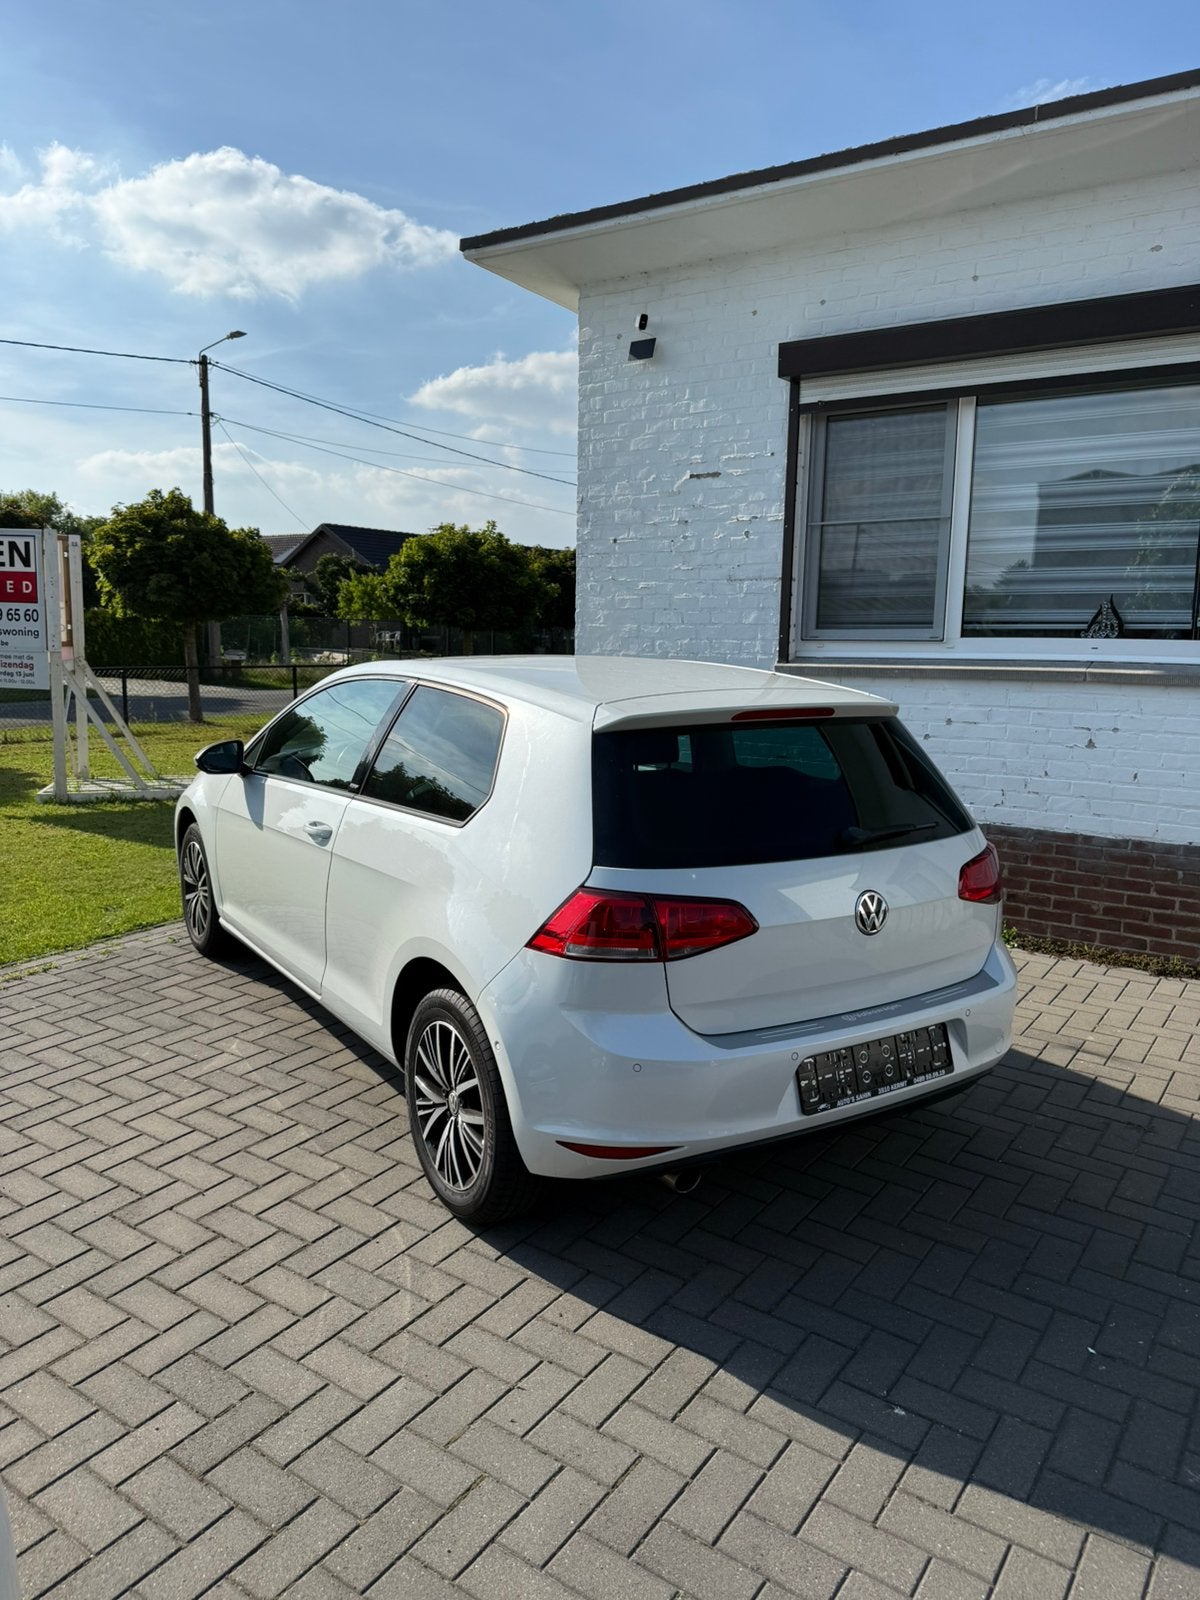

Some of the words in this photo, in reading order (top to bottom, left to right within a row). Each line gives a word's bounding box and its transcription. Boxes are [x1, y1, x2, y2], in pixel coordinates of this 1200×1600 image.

[0, 540, 31, 568] N
[6, 608, 21, 622] 65
[23, 608, 39, 622] 60
